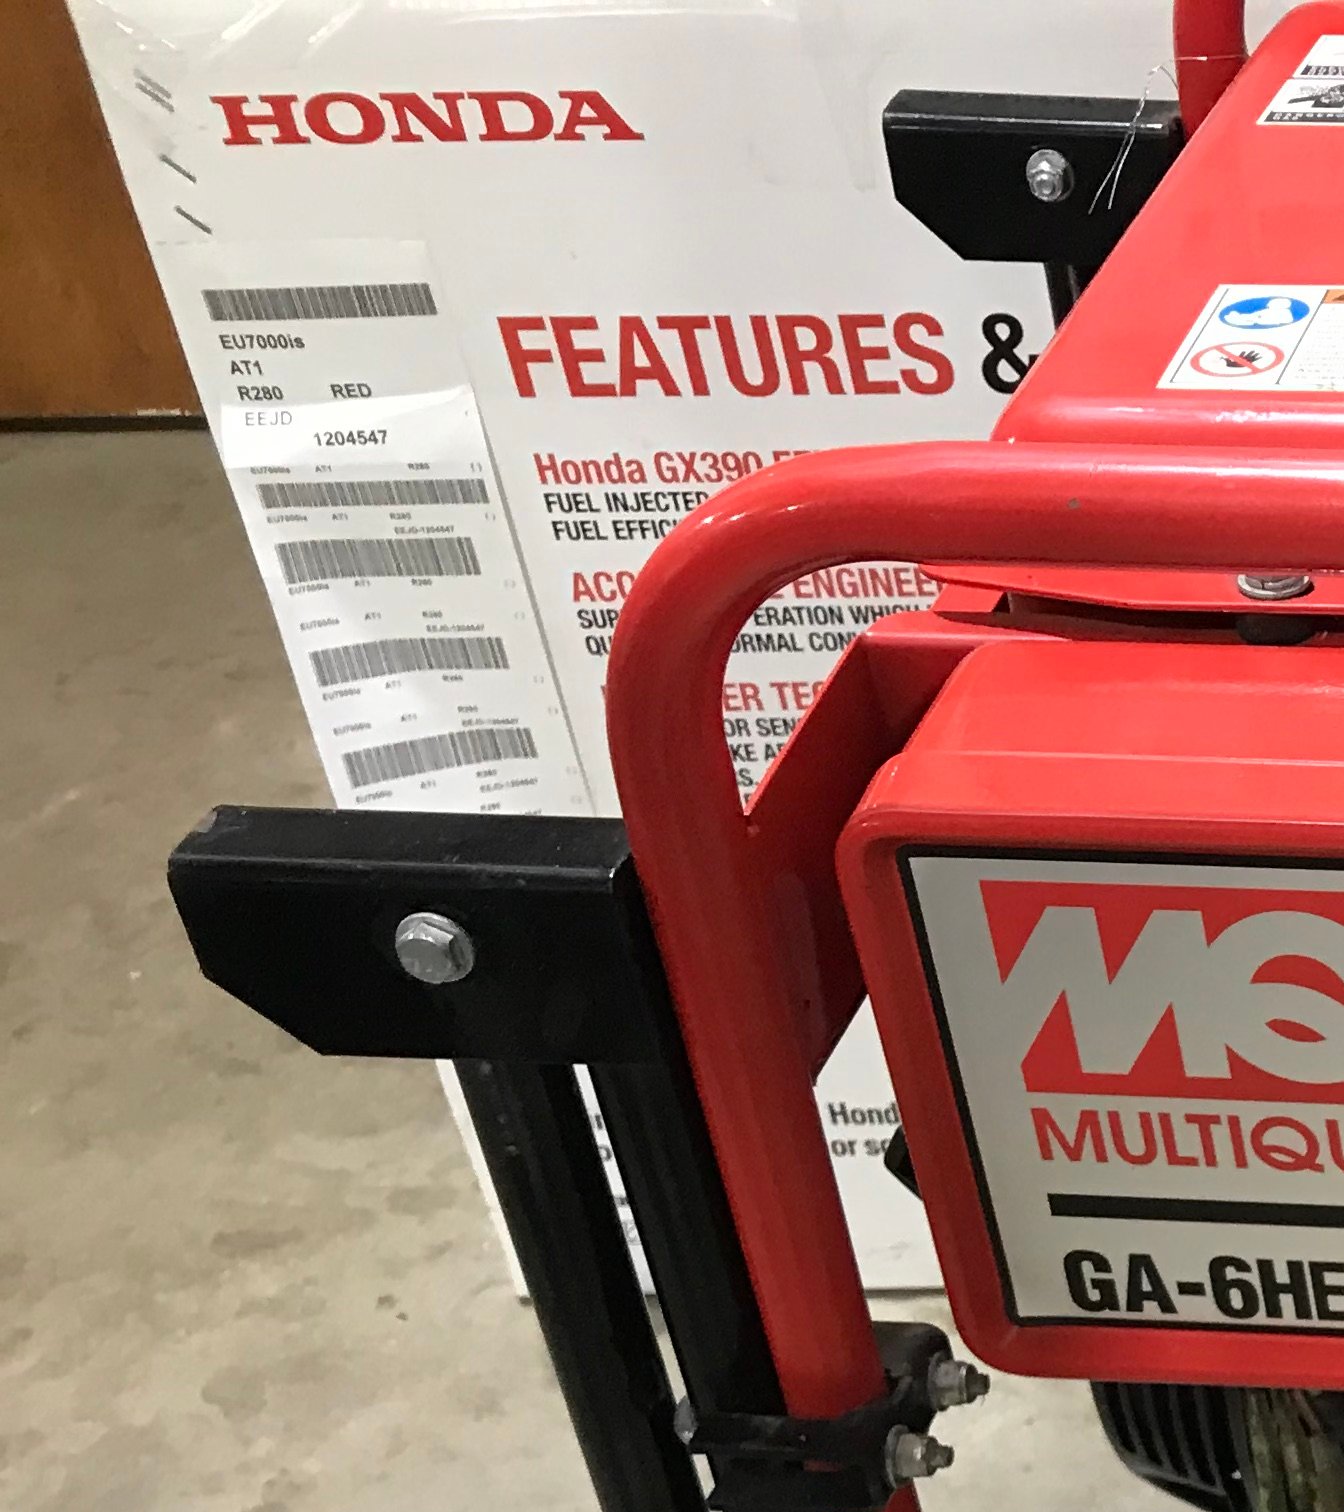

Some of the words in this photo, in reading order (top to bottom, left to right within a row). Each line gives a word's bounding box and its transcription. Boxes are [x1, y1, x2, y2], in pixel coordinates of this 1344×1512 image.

[209, 90, 645, 145] HONDA
[219, 333, 305, 350] EU7000is
[497, 312, 955, 397] FEATURES
[981, 313, 1037, 395] &
[230, 360, 264, 375] AT1
[238, 386, 284, 401] R280
[330, 383, 372, 399] RED
[244, 411, 293, 426] EEJD
[313, 429, 388, 446] 1204547
[533, 452, 648, 485] Honda
[653, 451, 764, 484] GX390
[544, 491, 600, 513] FUEL
[552, 519, 608, 541] FUEL
[792, 567, 945, 599] ENGINEE
[753, 605, 844, 627] ERATION
[732, 631, 804, 653] ORMAL
[828, 1102, 902, 1126] Hond
